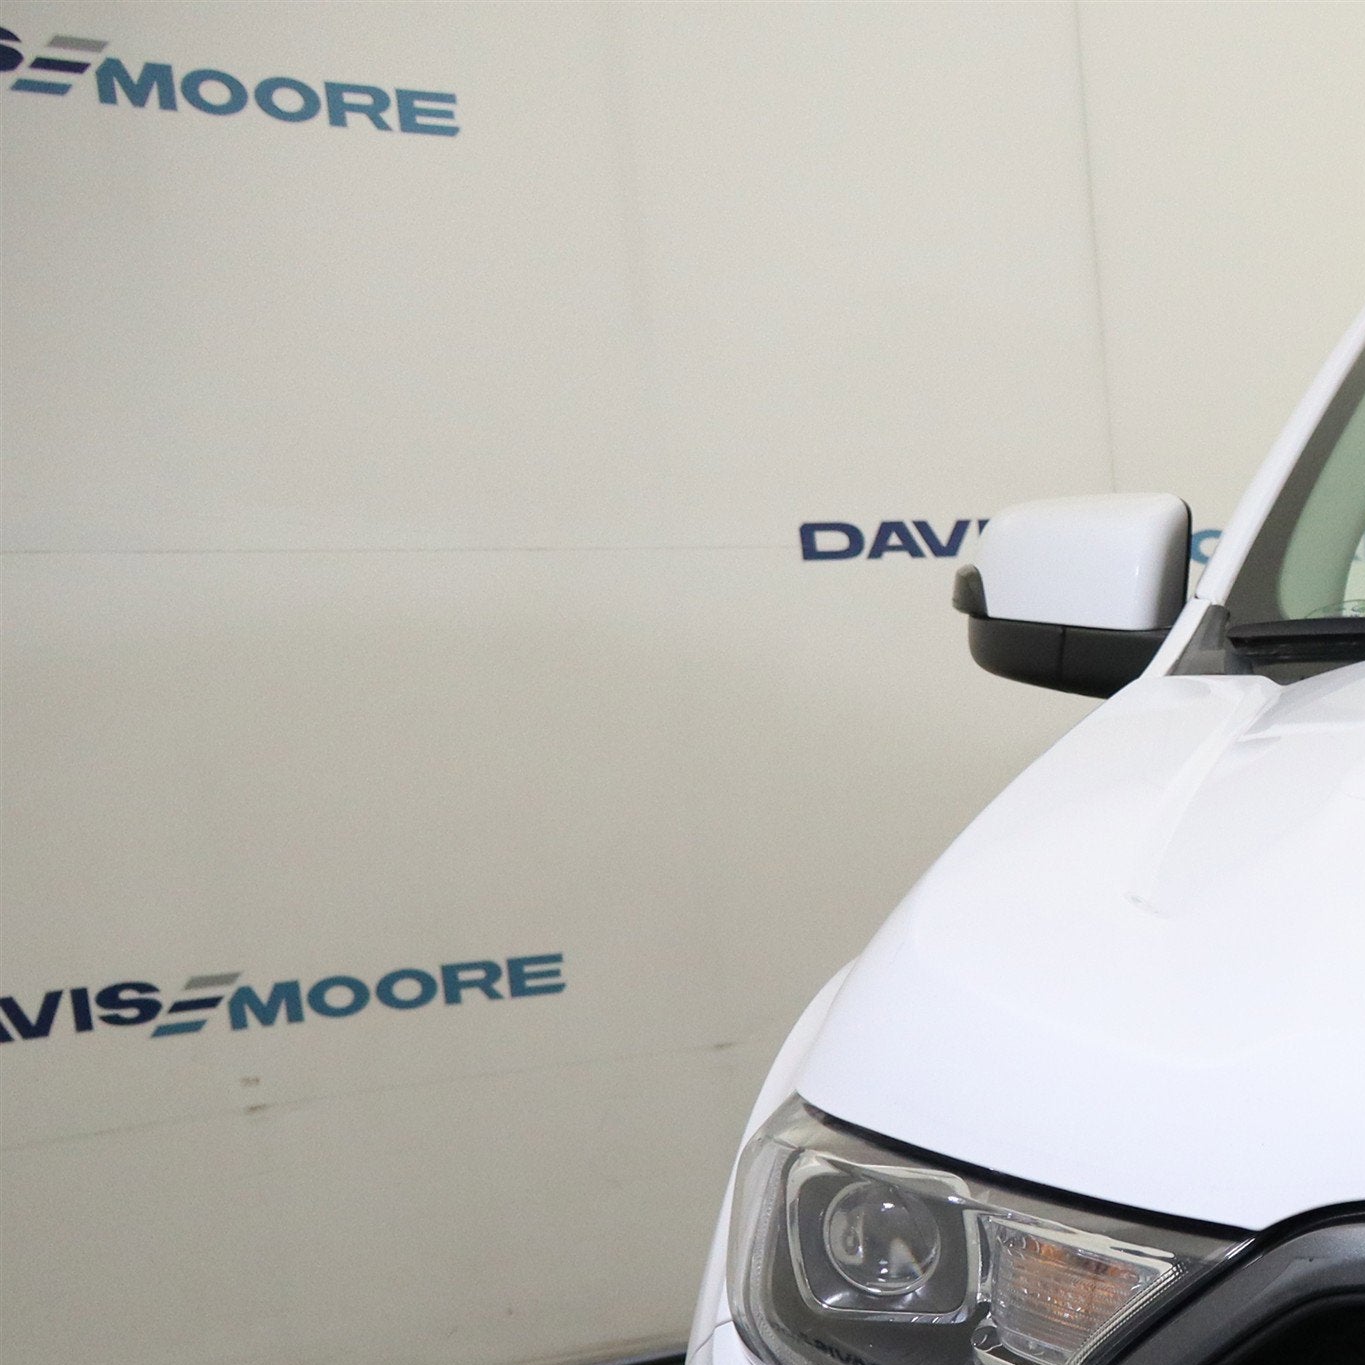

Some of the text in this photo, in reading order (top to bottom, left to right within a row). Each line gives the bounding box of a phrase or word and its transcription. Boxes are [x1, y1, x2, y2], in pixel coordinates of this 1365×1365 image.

[95, 56, 461, 138] MOORE
[799, 519, 990, 561] DAV
[0, 952, 566, 1043] VIS MOORE
